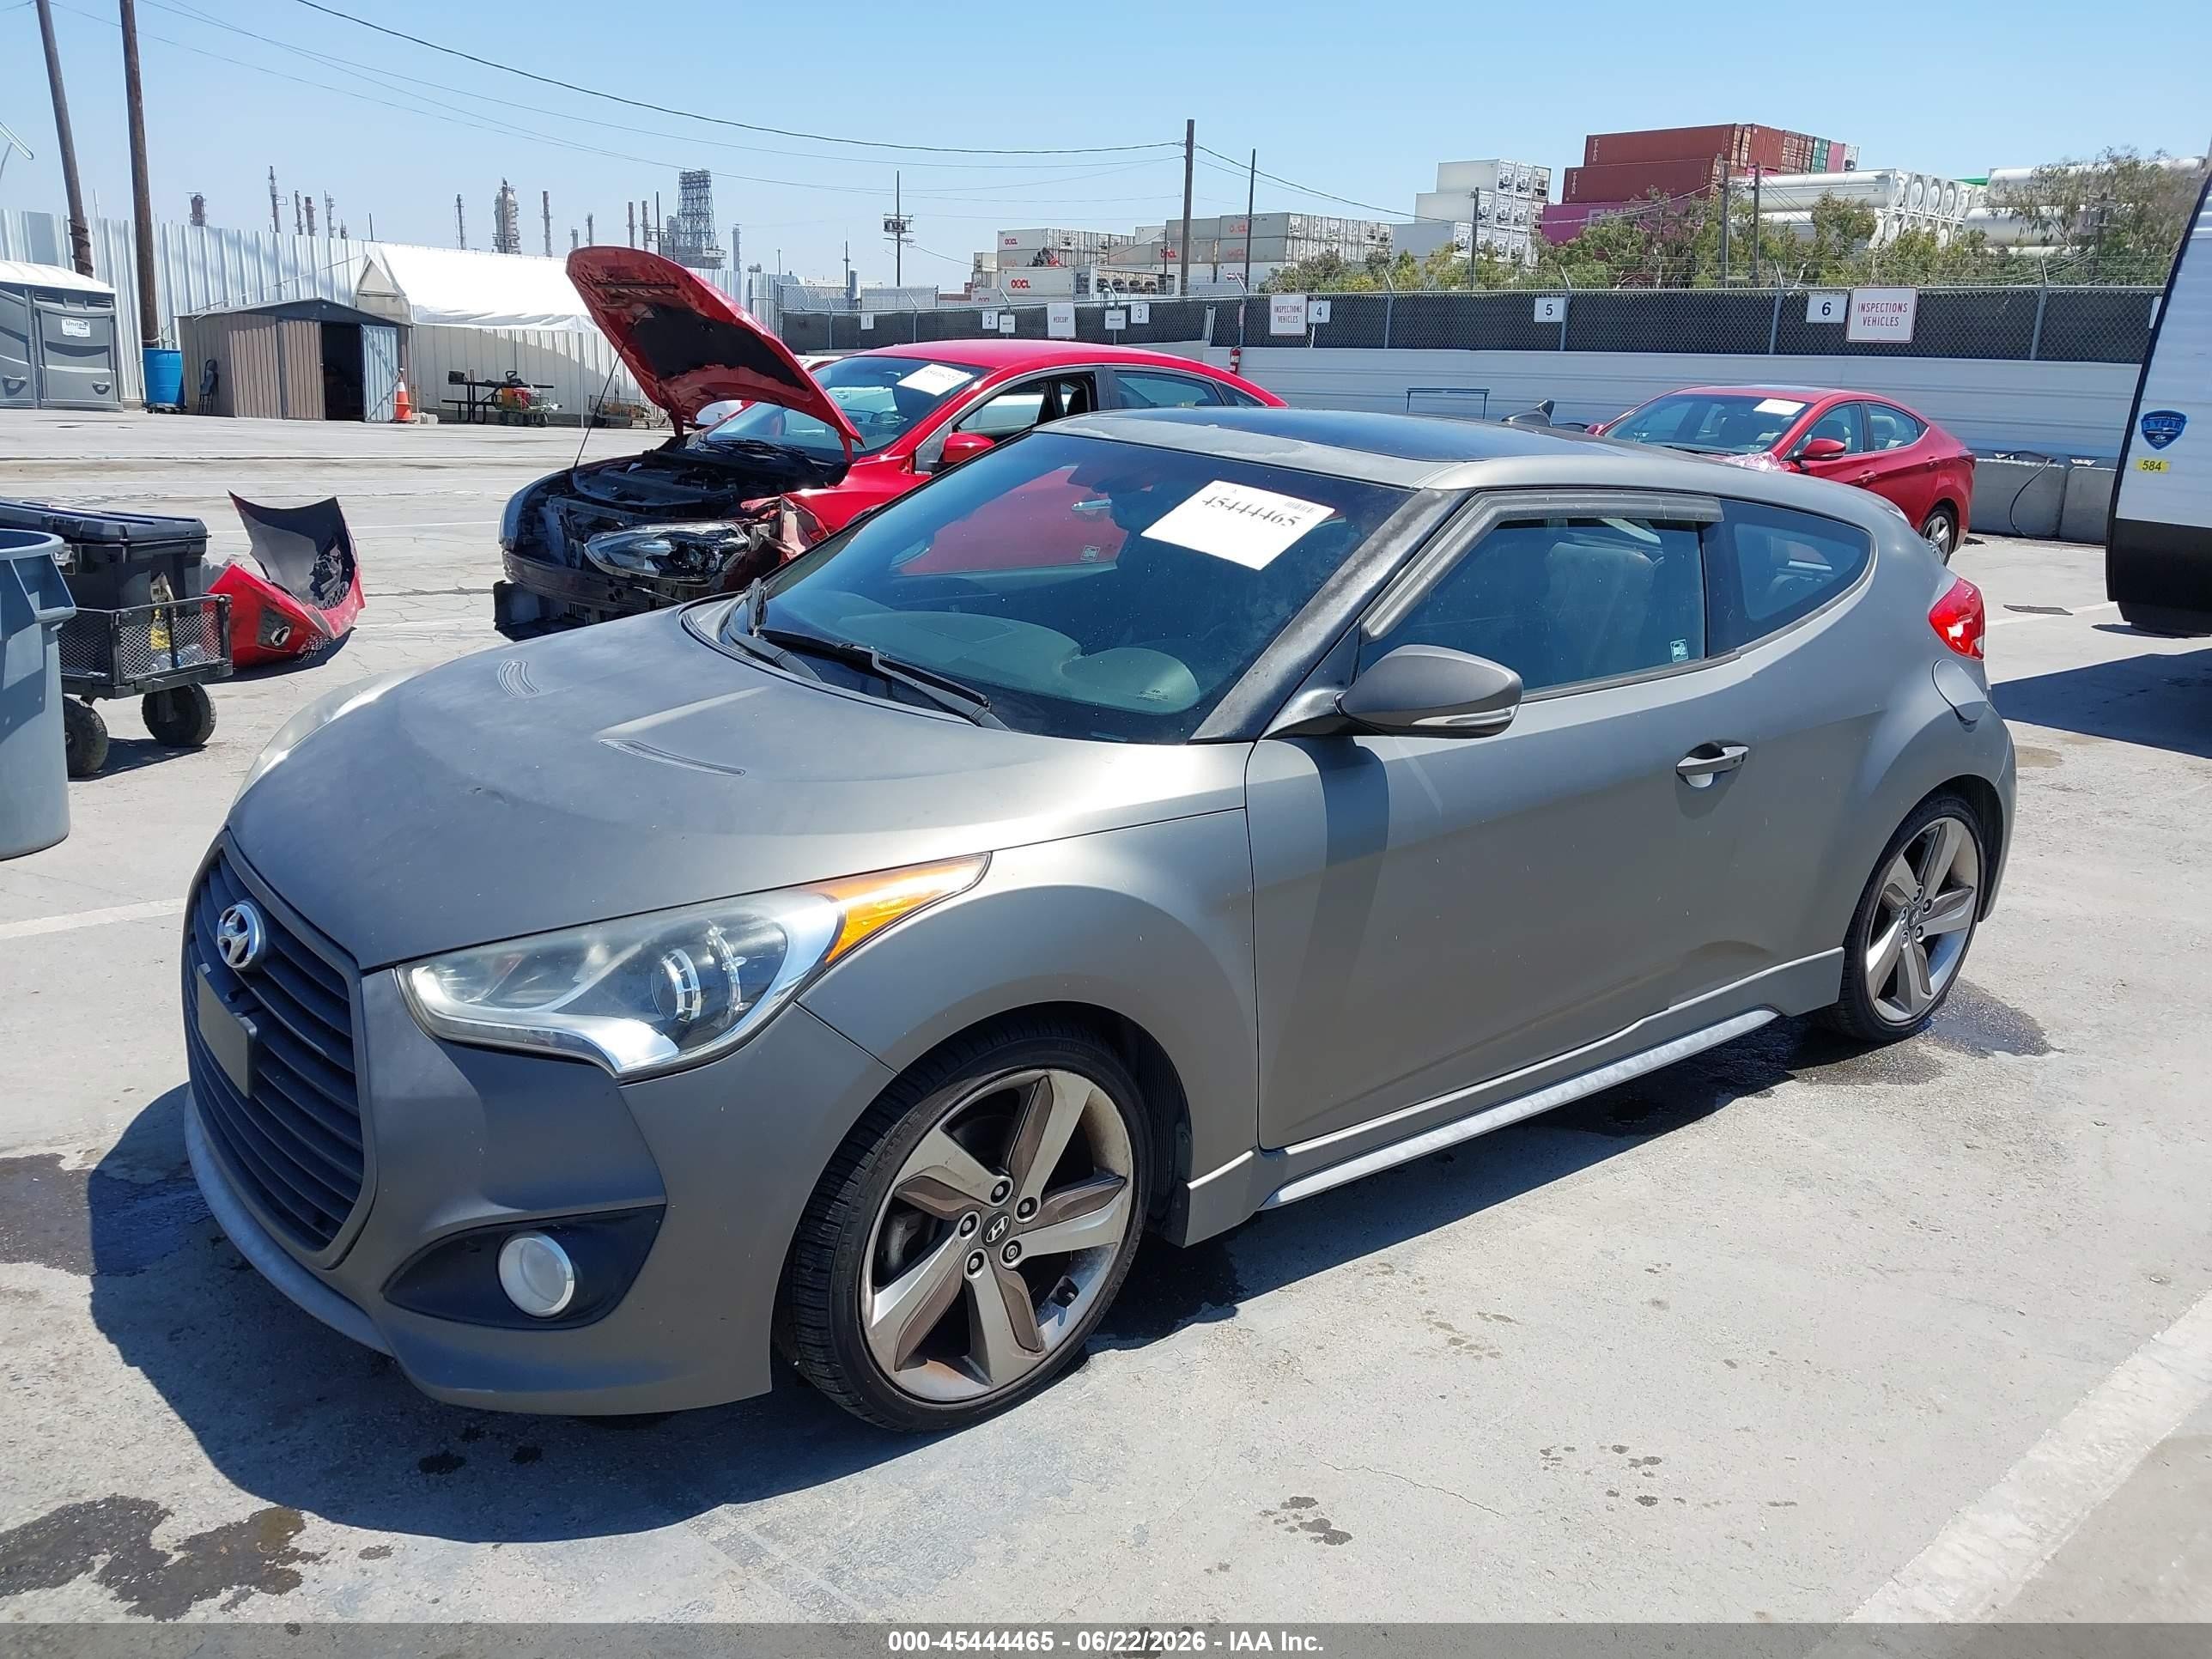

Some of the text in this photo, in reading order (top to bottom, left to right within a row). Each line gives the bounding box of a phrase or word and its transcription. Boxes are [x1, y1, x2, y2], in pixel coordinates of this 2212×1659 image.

[1011, 279, 1030, 289] OOCL
[1273, 305, 1303, 313] INSPECTIONS
[1316, 306, 1323, 318] 4
[1546, 303, 1553, 316] 5
[1821, 301, 1832, 316] 6
[1857, 302, 1908, 313] INSPECTIONS
[1137, 308, 1143, 319] 3
[988, 315, 993, 325] 2
[1277, 315, 1298, 324] VEHICLES
[1863, 316, 1899, 327] VEHICLES
[2142, 460, 2162, 471] 584
